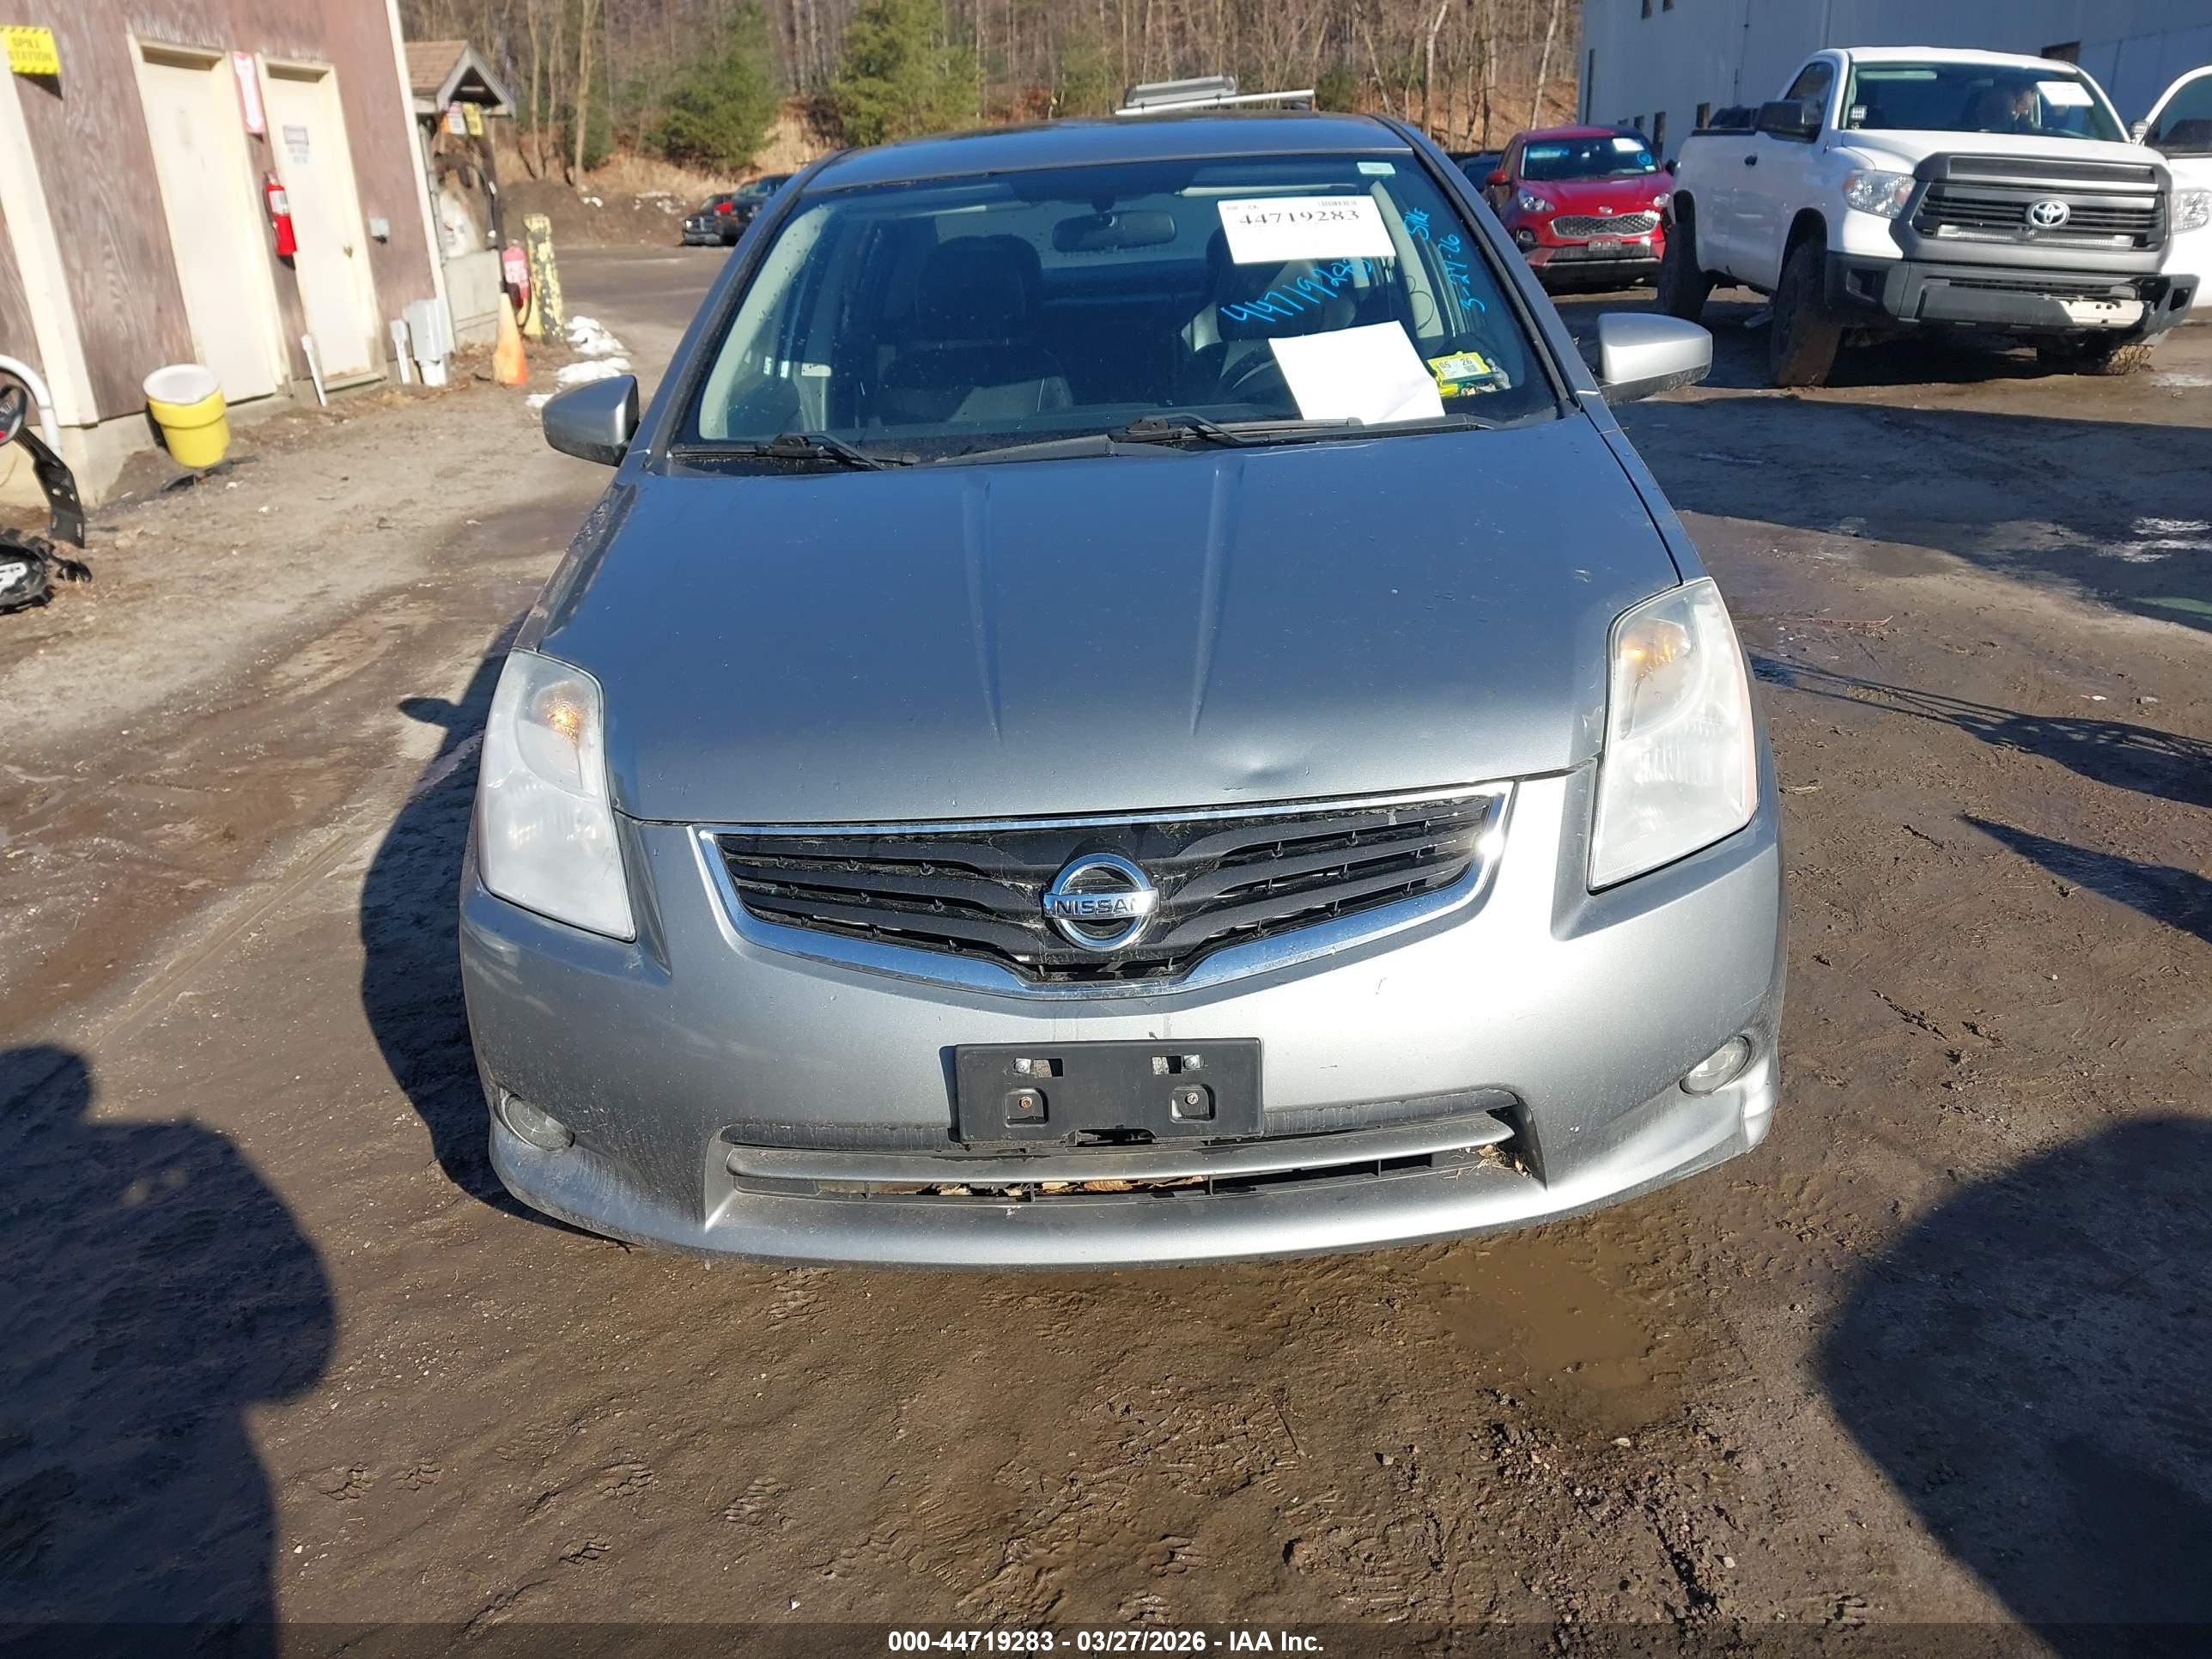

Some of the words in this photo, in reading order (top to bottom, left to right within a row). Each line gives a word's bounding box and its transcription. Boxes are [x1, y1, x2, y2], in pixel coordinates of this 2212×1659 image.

[1239, 210, 1360, 226] 44719283
[1438, 361, 1451, 369] 05
[1460, 357, 1474, 366] 26
